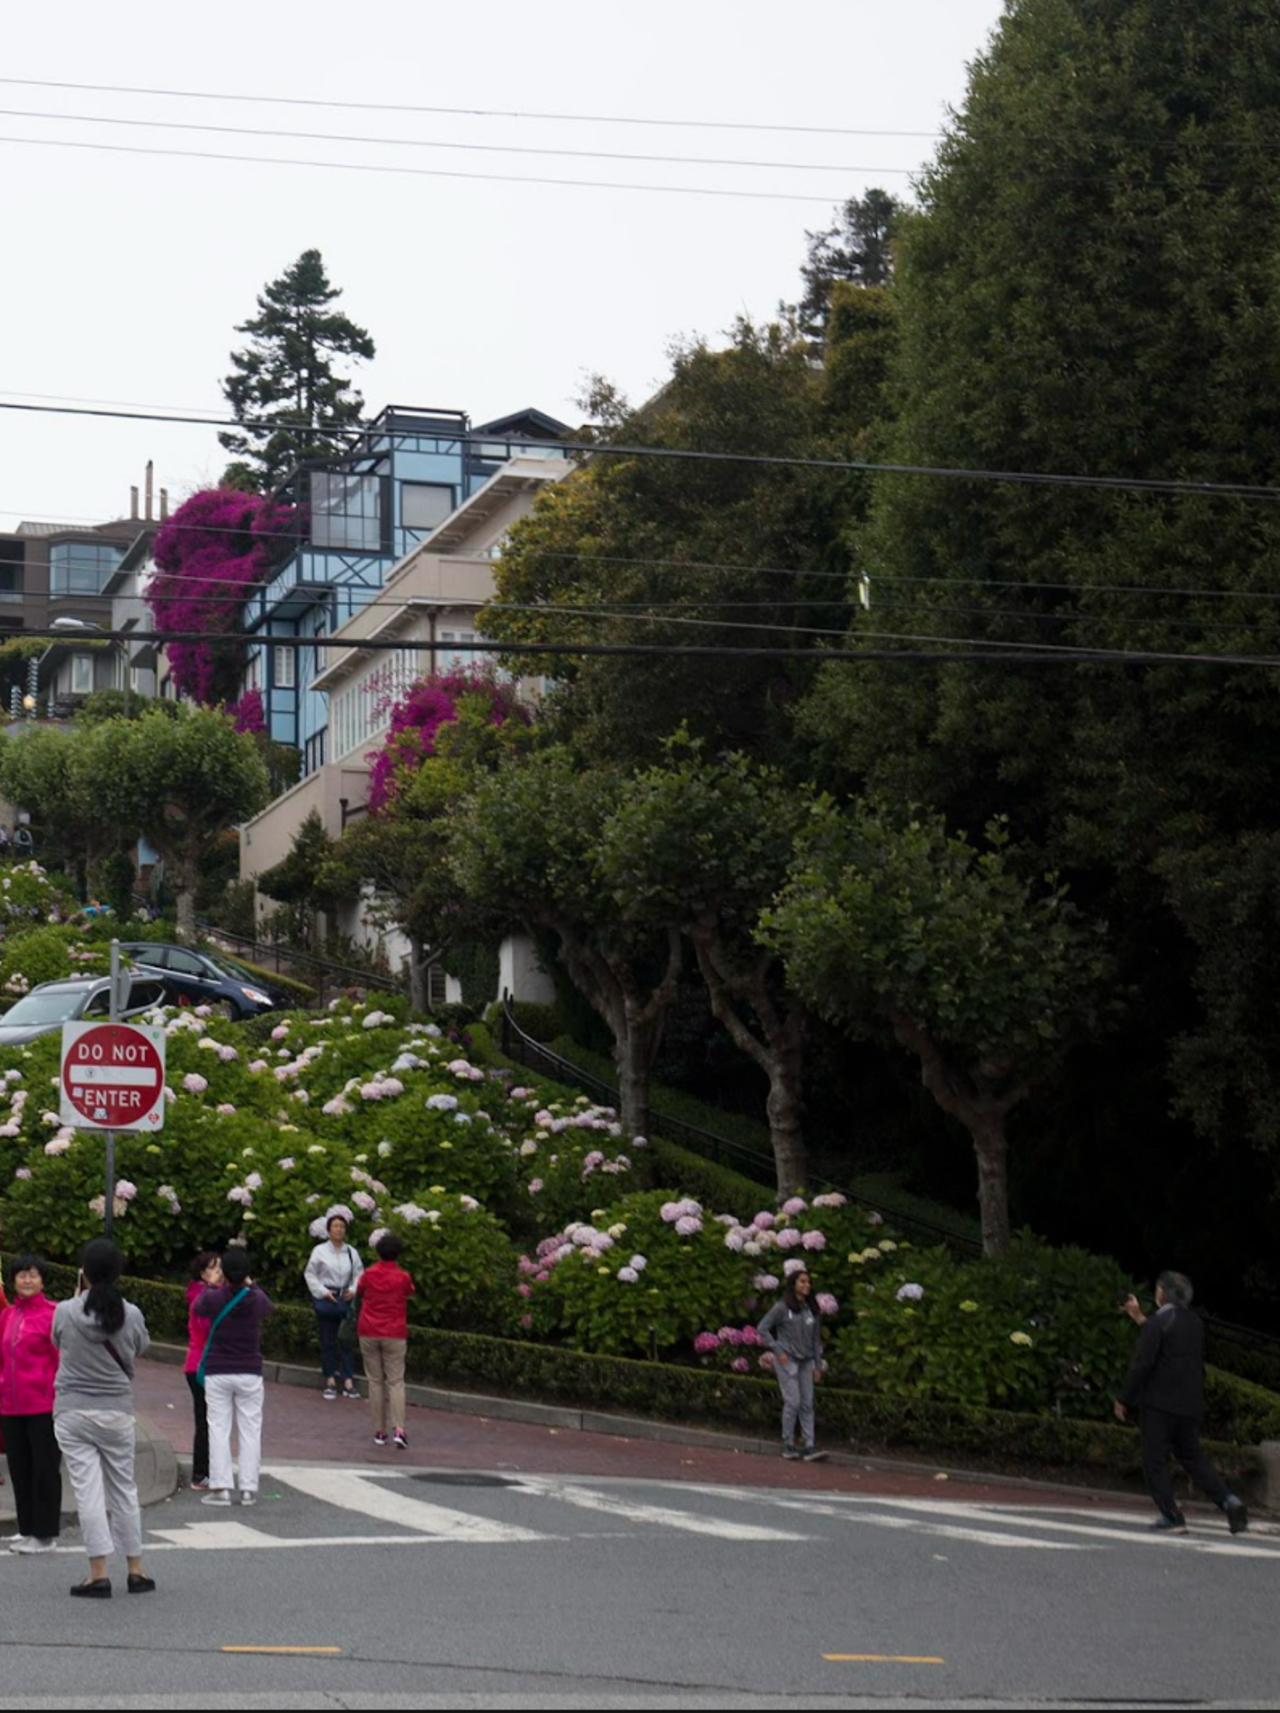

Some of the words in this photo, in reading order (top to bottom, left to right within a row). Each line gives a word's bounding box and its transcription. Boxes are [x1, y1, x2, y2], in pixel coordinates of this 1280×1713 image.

[78, 1043, 104, 1060] DO
[112, 1045, 149, 1062] NOT
[84, 1089, 141, 1107] ENTER
